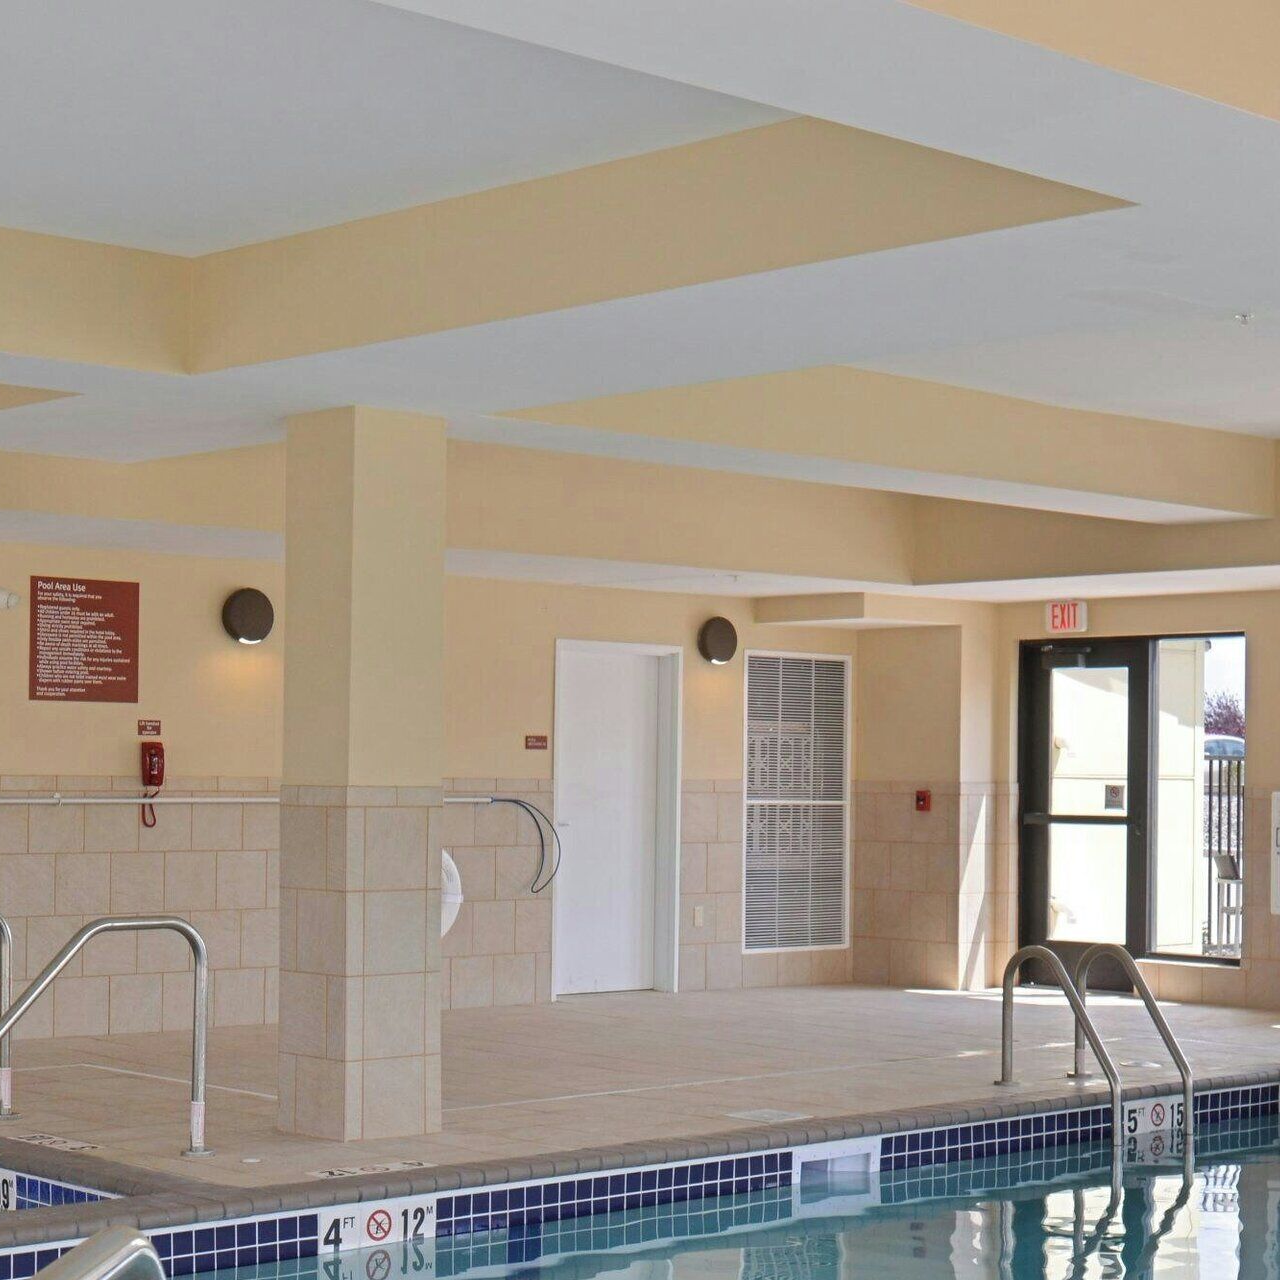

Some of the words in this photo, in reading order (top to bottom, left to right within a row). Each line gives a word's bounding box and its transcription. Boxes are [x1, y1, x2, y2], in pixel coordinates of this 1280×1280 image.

[37, 581, 54, 590] Pool
[55, 582, 71, 591] Area
[73, 583, 86, 592] Use
[1051, 603, 1078, 629] EXIT
[1127, 1109, 1138, 1133] 5
[426, 1206, 433, 1215] M
[323, 1218, 342, 1250] 4
[343, 1216, 355, 1229] FT
